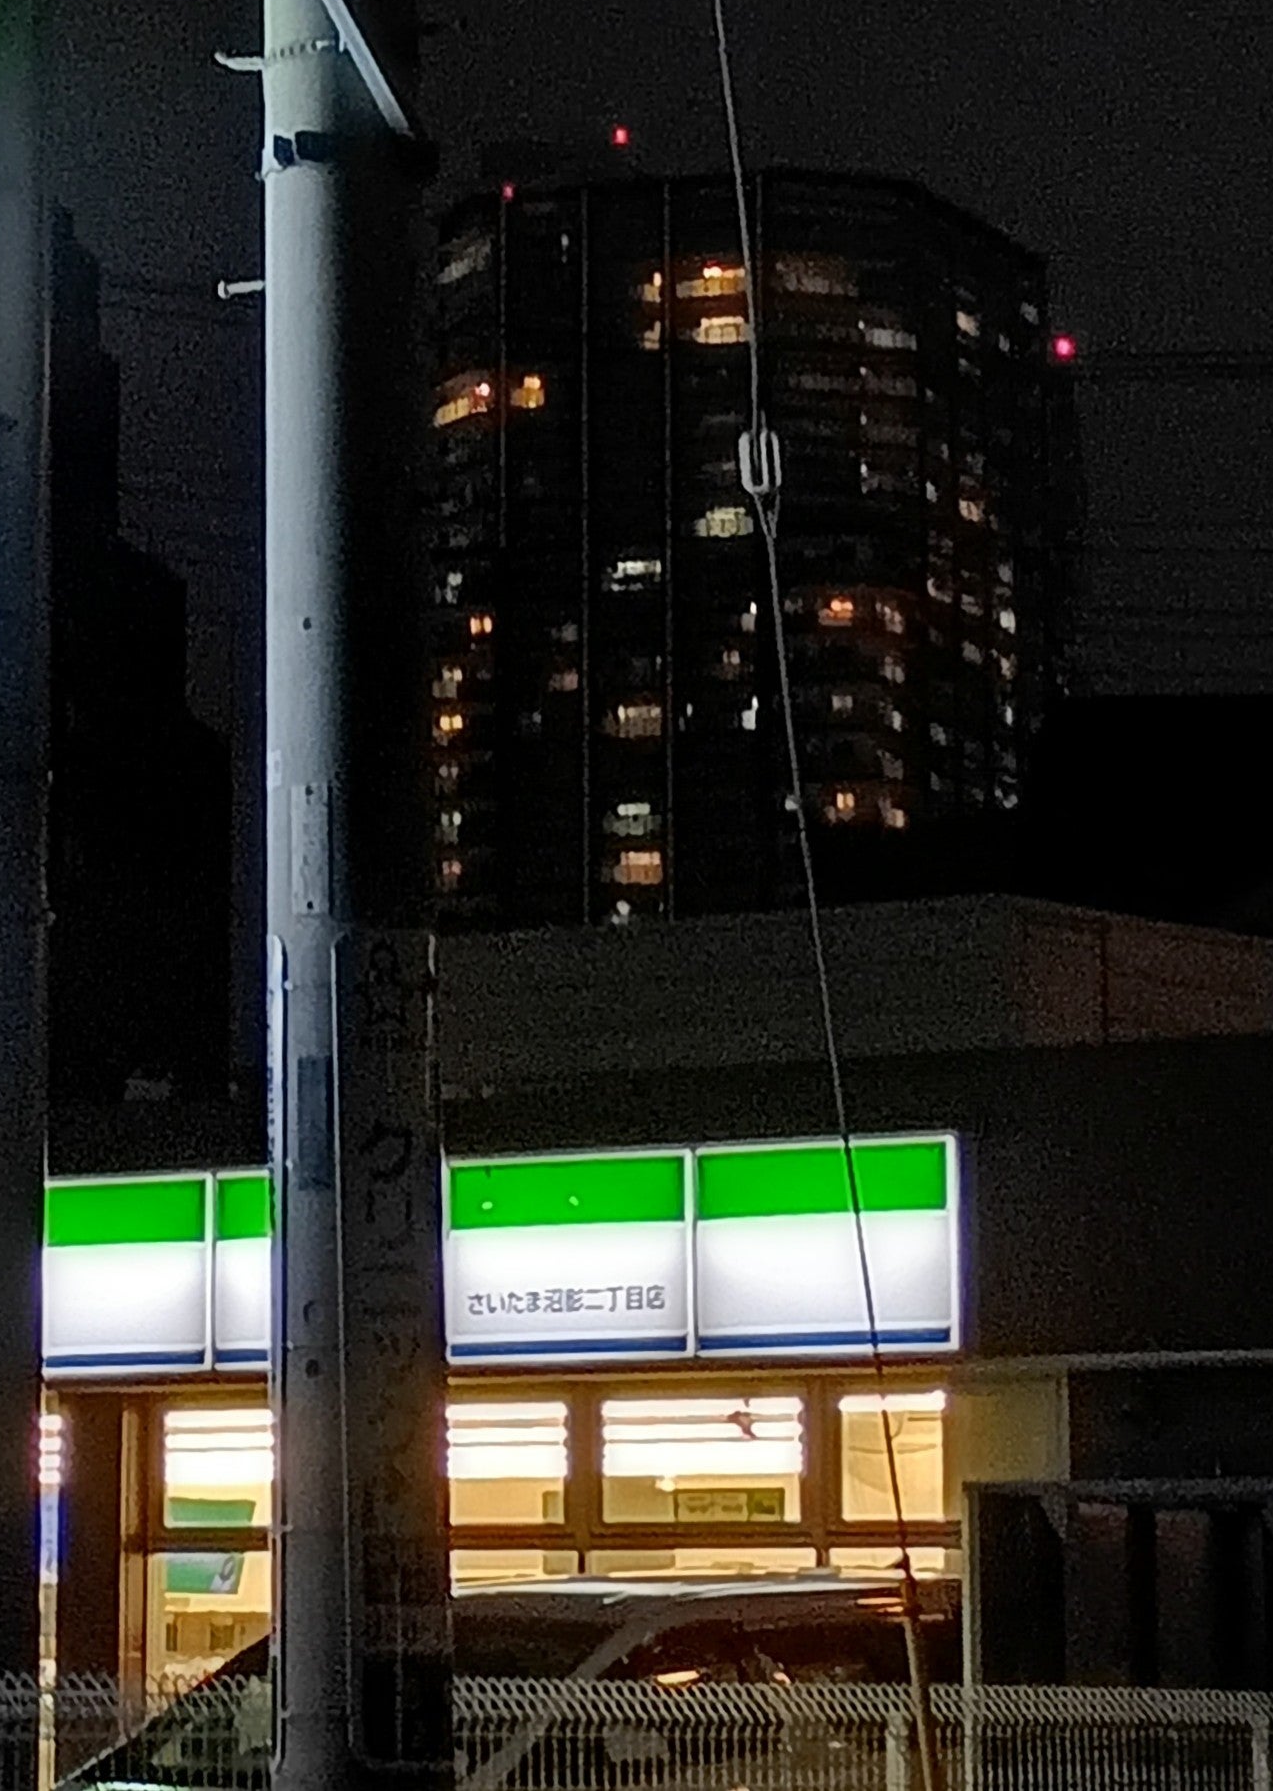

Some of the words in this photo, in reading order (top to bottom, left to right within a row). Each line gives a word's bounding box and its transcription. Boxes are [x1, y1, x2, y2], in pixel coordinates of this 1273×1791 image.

[467, 1284, 666, 1316] さいたま沼影二丁目店
